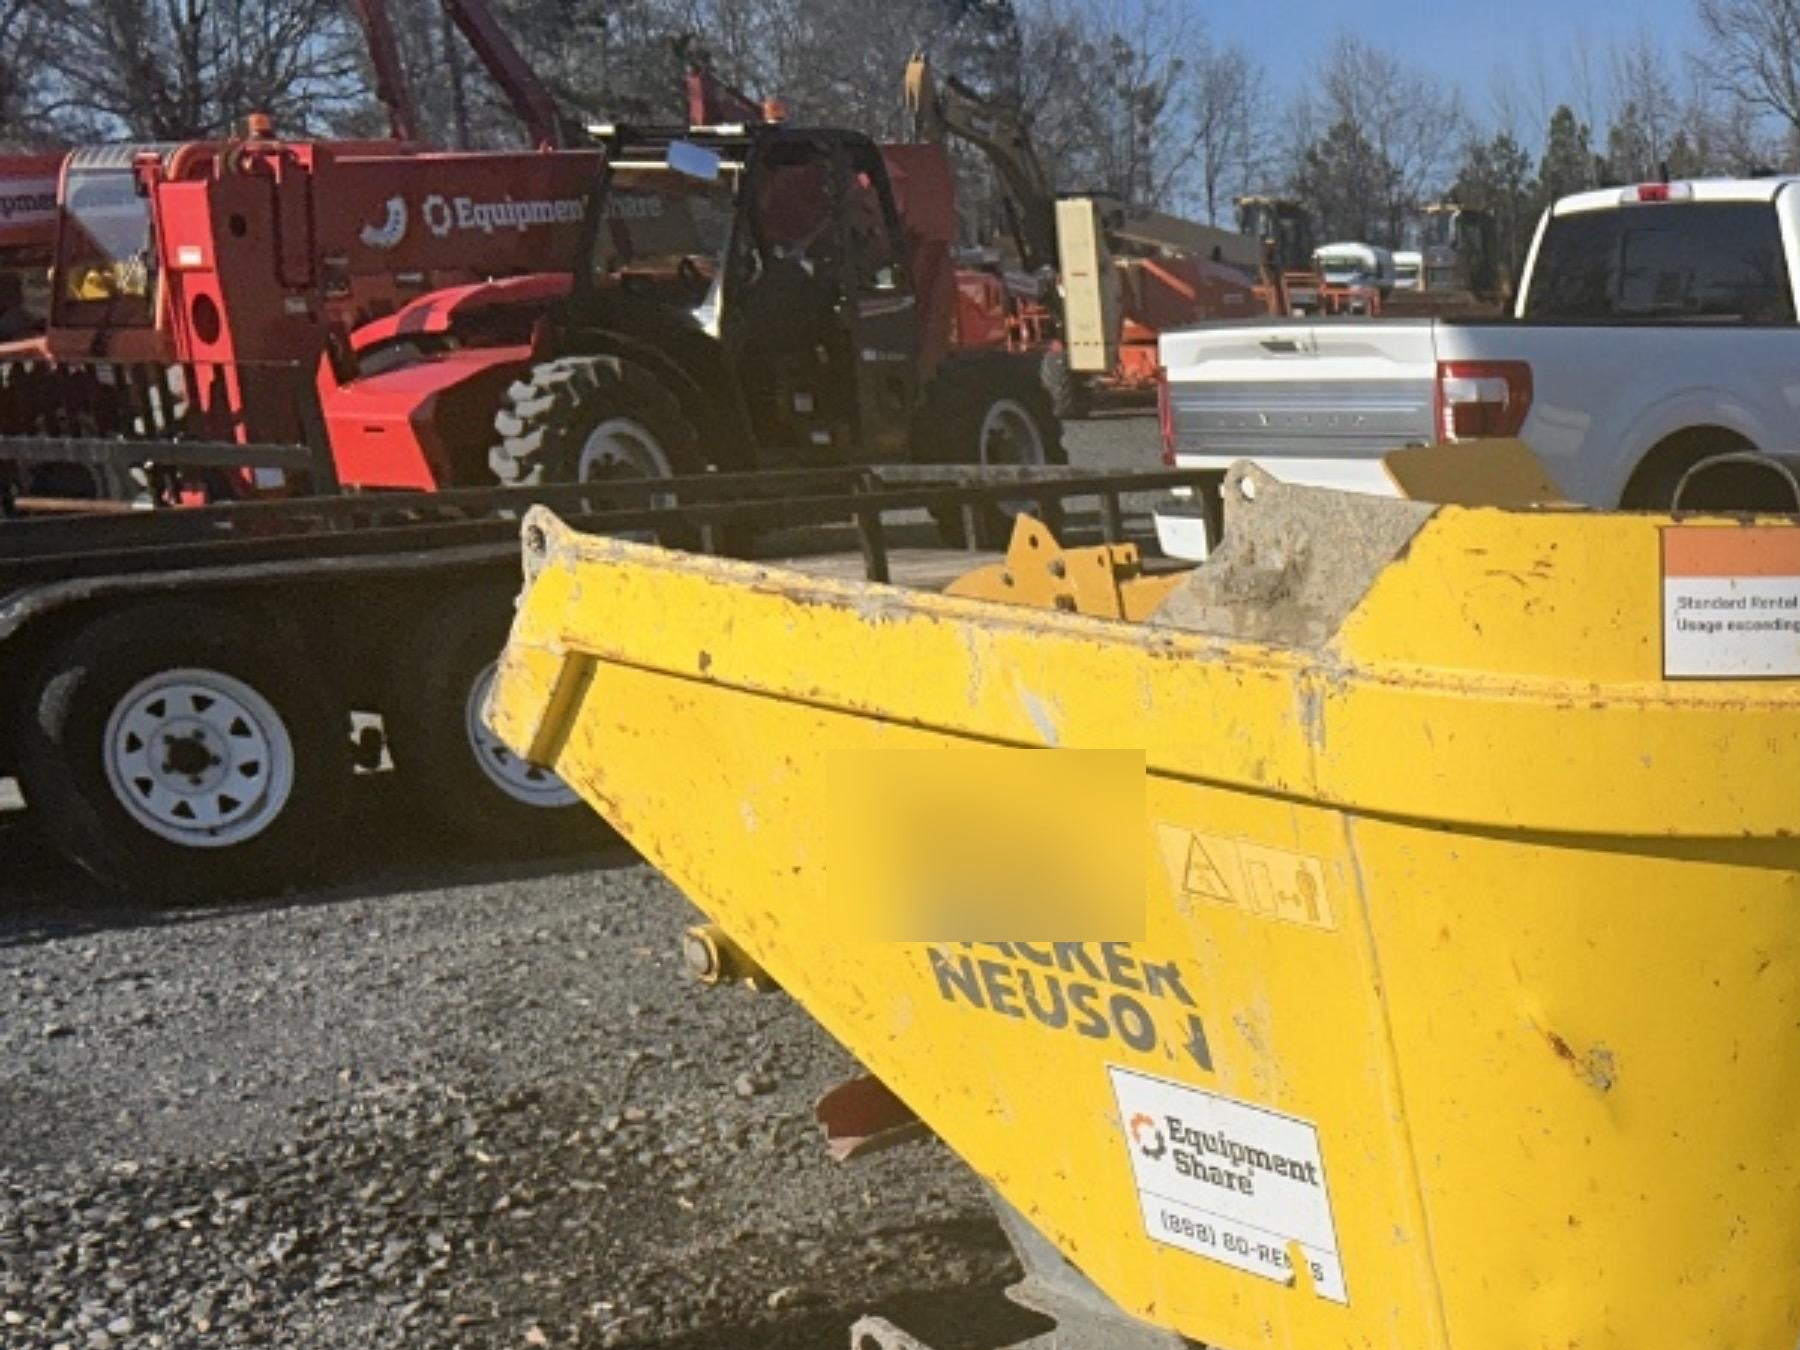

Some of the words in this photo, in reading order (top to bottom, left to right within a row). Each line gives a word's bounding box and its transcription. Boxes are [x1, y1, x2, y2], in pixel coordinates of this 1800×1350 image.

[1677, 596, 1746, 610] Standard
[1751, 595, 1797, 609] Rental
[1677, 618, 1723, 634] Usage
[1727, 617, 1800, 634] exceeding
[1164, 1114, 1320, 1187] Equipment
[1172, 1148, 1255, 1197] Share
[1160, 1208, 1217, 1248] (888)
[1222, 1231, 1325, 1283] 80-RENS
